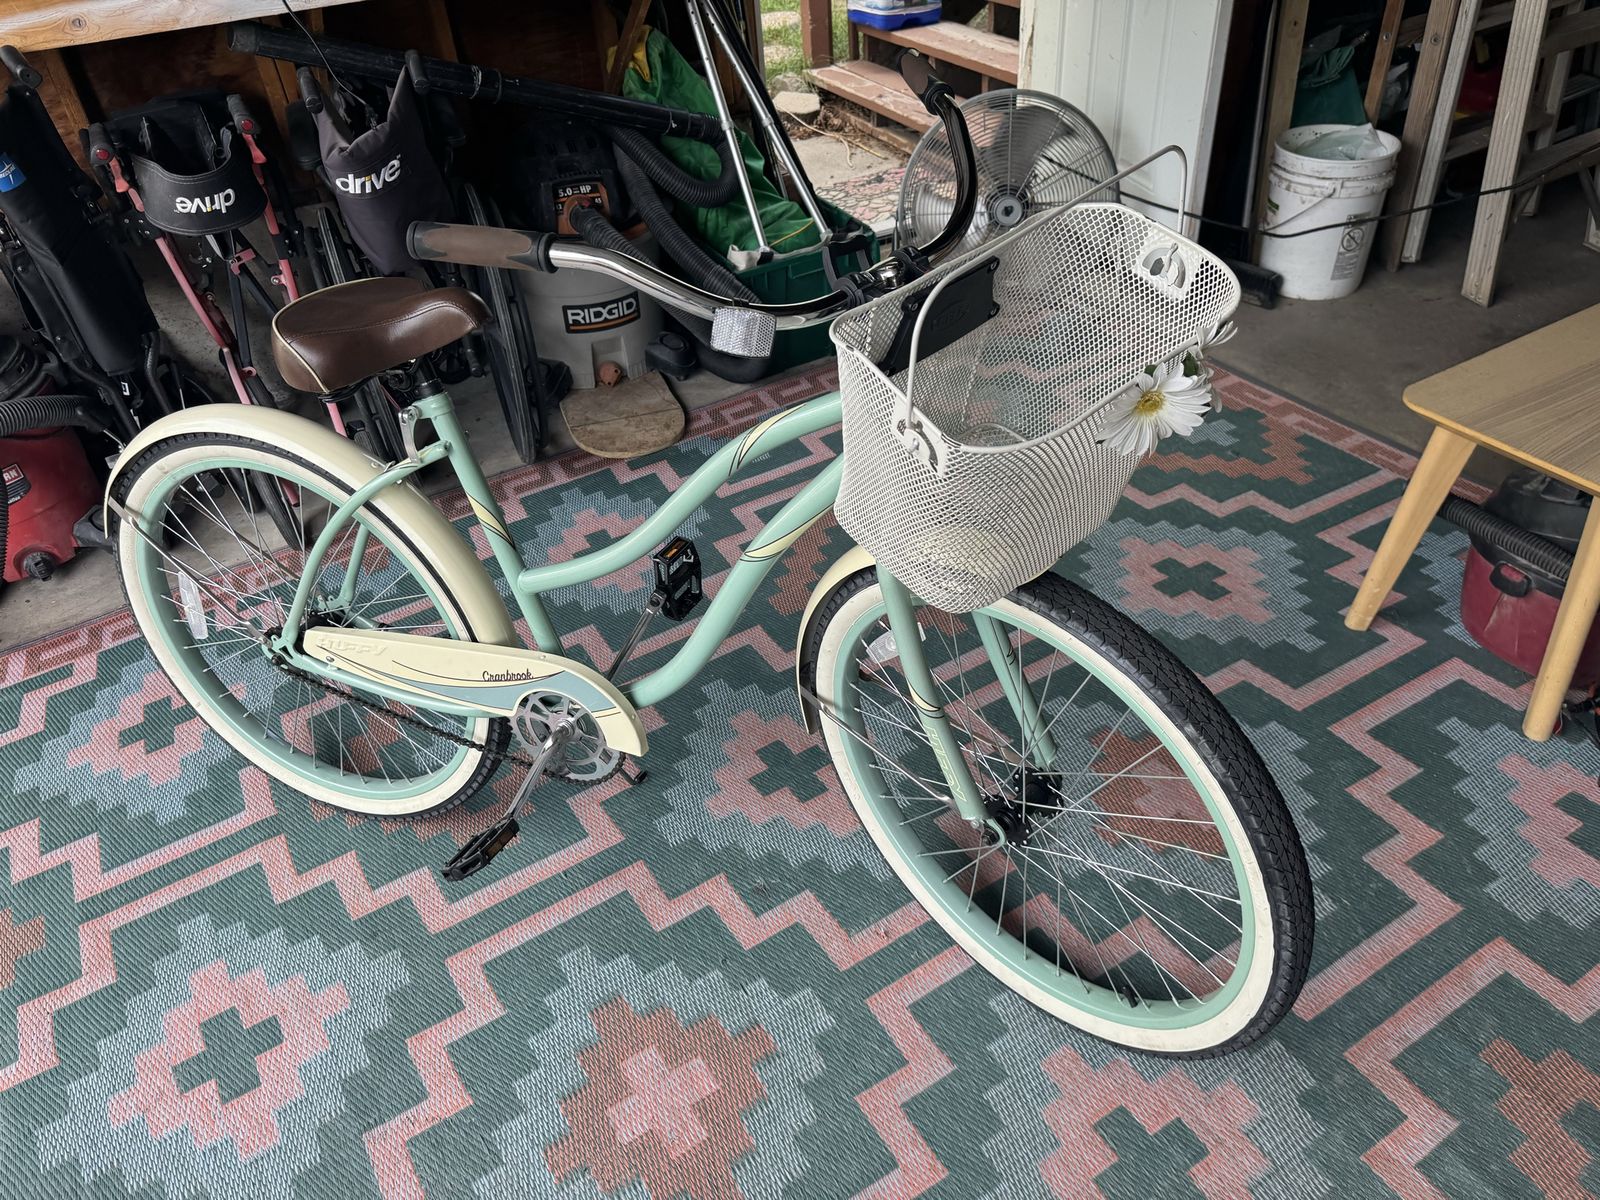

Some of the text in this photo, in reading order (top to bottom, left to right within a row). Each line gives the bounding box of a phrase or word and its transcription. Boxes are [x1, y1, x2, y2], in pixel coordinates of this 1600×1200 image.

[336, 159, 401, 194] drive
[175, 188, 236, 214] drive
[558, 187, 573, 197] 5.0
[579, 184, 592, 194] HP
[566, 297, 637, 325] RIDGID
[482, 667, 533, 682] Cranbrook
